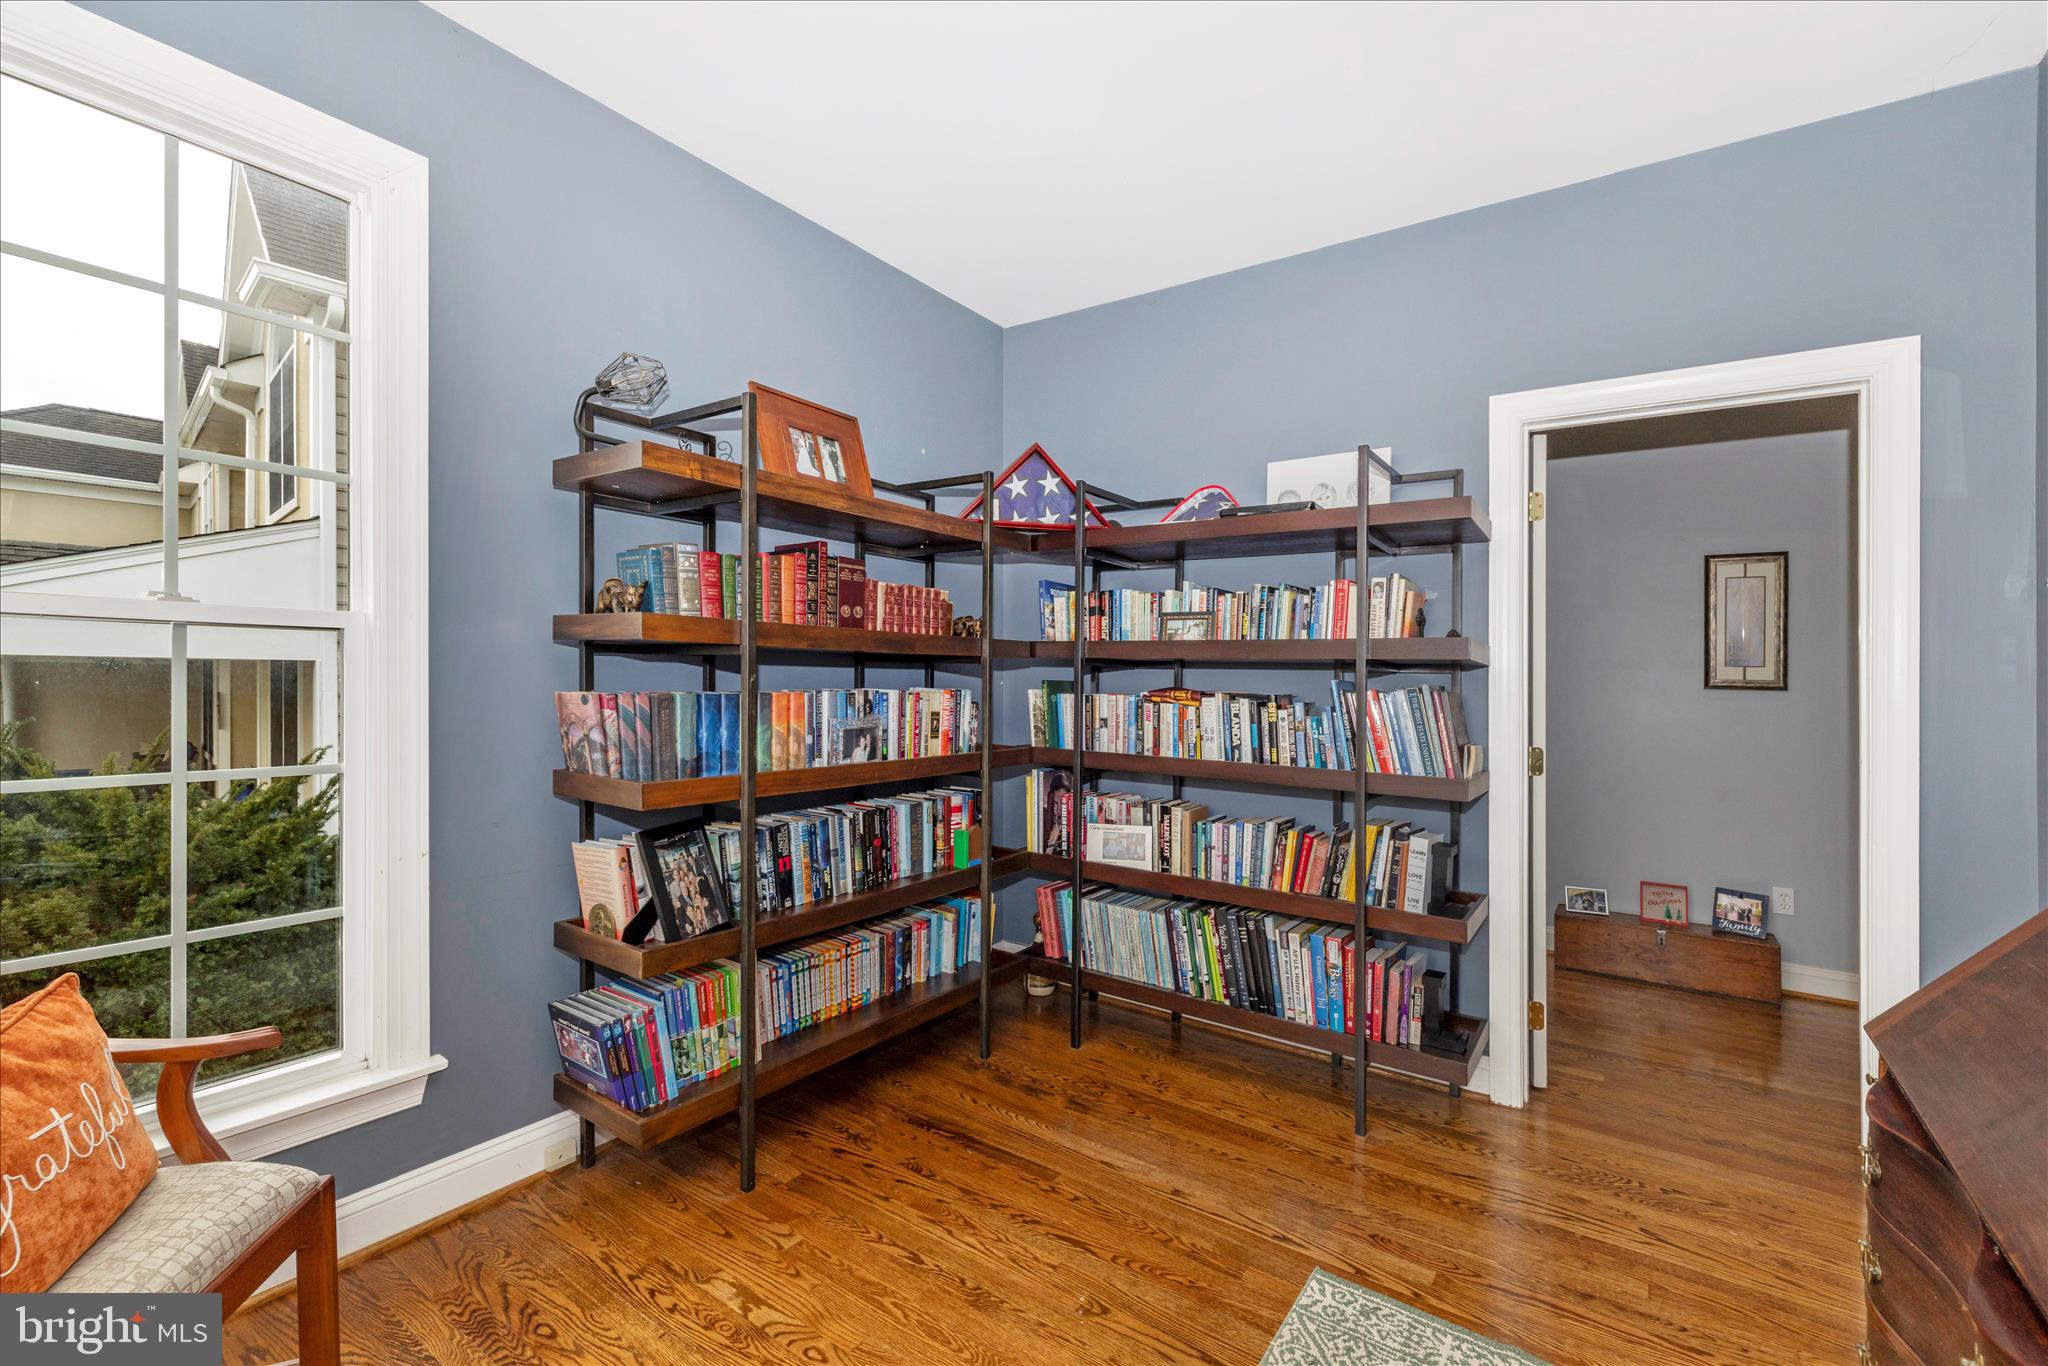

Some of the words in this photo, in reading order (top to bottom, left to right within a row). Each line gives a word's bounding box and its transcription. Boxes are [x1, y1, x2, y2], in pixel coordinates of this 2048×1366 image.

[1377, 600, 1385, 638] KATHARIN
[942, 694, 950, 731] AIRFRAME
[1268, 702, 1277, 722] GUTS
[1413, 709, 1422, 725] FIRST
[1231, 703, 1240, 747] BLANDA
[1416, 725, 1426, 742] STATE
[1419, 743, 1433, 777] UNIVERSITY
[776, 832, 785, 853] KING
[779, 825, 790, 856] STEPHEN
[1163, 842, 1171, 858] LOT
[1409, 848, 1426, 857] LEARN
[1408, 871, 1422, 880] LOVE
[1407, 896, 1420, 904] LIVE
[1218, 924, 1228, 951] Yackety
[1222, 953, 1232, 970] Yack
[1292, 948, 1298, 959] AP
[1329, 968, 1341, 1000] Biology
